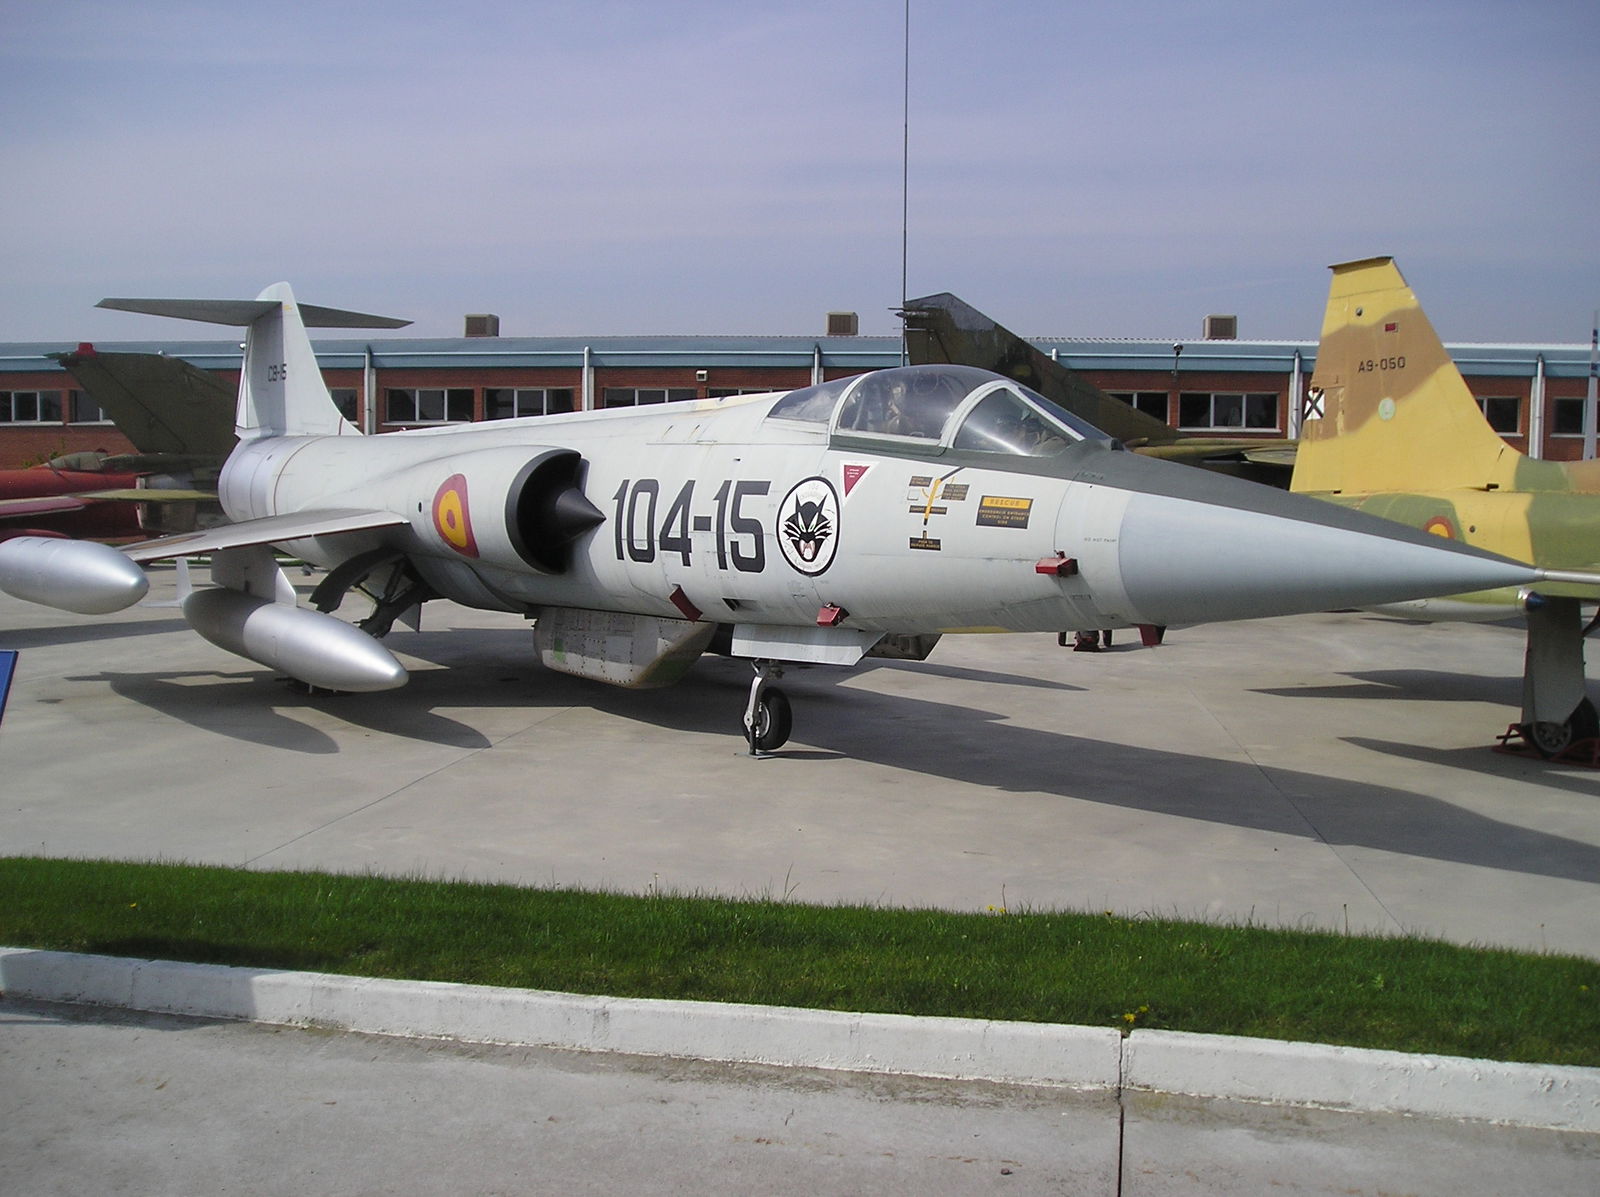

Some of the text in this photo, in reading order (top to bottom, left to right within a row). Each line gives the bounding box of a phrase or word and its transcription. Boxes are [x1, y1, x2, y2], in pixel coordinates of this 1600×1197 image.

[1358, 356, 1406, 373] A9-050
[990, 498, 1020, 506] RESCUE
[612, 479, 772, 573] 104-15
